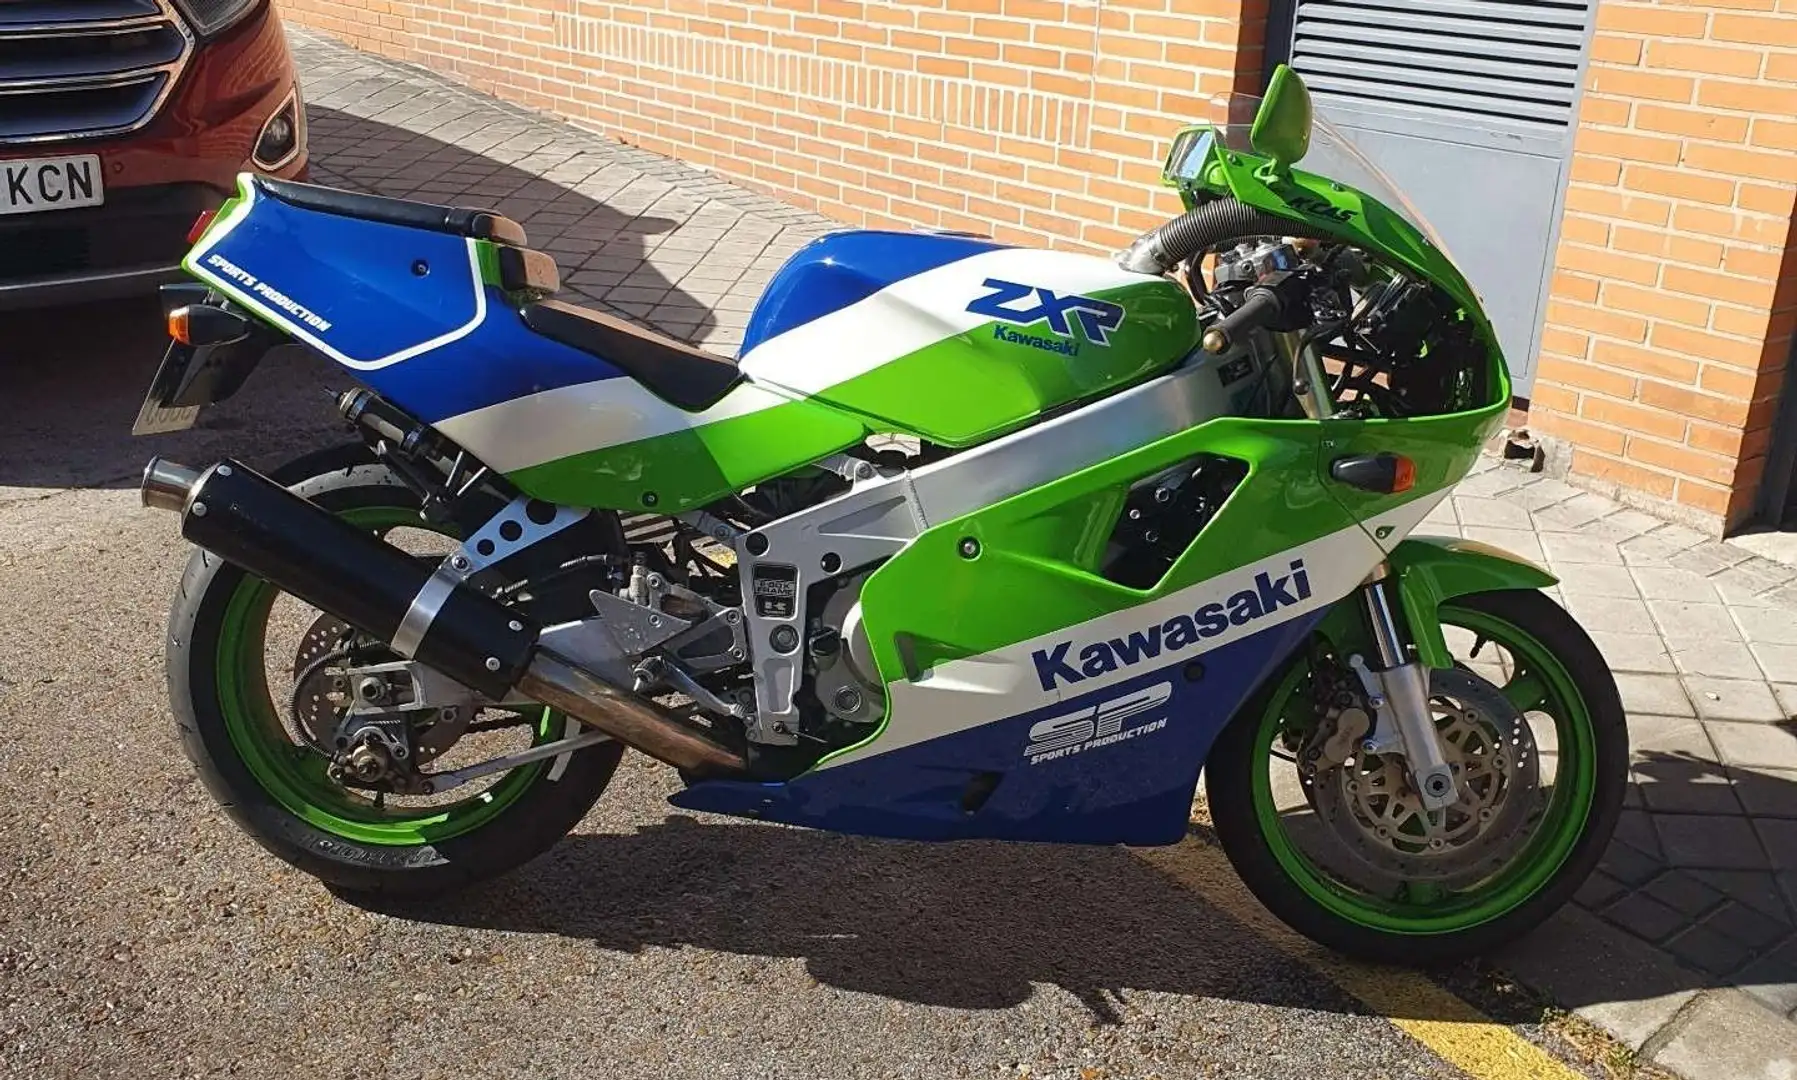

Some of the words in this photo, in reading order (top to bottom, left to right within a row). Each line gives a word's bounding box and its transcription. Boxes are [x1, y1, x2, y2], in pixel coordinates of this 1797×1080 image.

[6, 161, 93, 205] KCN
[207, 254, 258, 287] SPORTS
[253, 282, 332, 332] PRODUCTION
[965, 277, 1127, 347] ZXR
[992, 324, 1081, 357] Kawasaki
[1031, 558, 1312, 692] Kawasaki
[1023, 680, 1173, 757] SP
[1029, 745, 1082, 766] SPORTS
[1083, 716, 1168, 752] PRODUCTION
